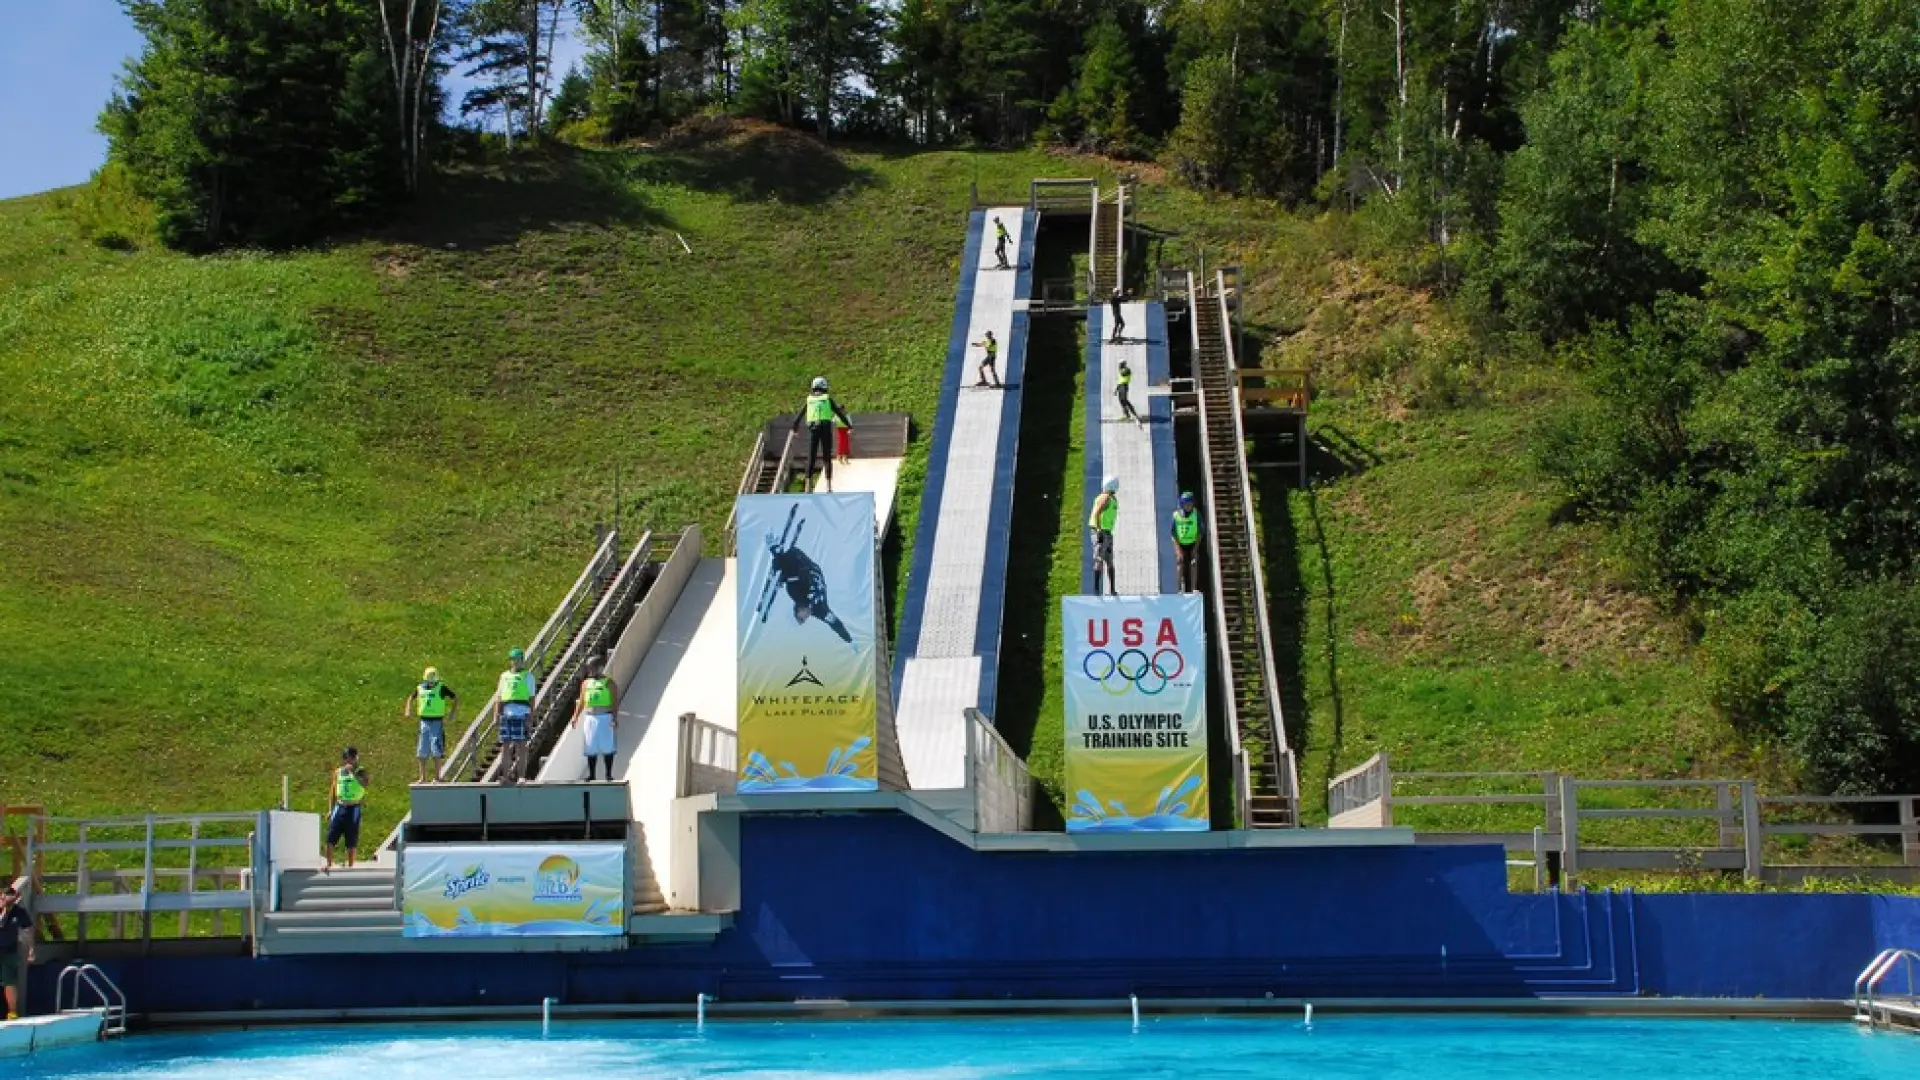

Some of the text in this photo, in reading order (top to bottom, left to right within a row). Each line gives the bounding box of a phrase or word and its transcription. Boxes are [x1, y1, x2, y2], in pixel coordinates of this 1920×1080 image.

[1088, 617, 1178, 647] USA
[752, 695, 861, 705] WHITEFACE
[1088, 713, 1182, 730] U.S. OLYMPIC
[1083, 731, 1189, 748] TRAINING SITE
[443, 865, 491, 900] Sprite
